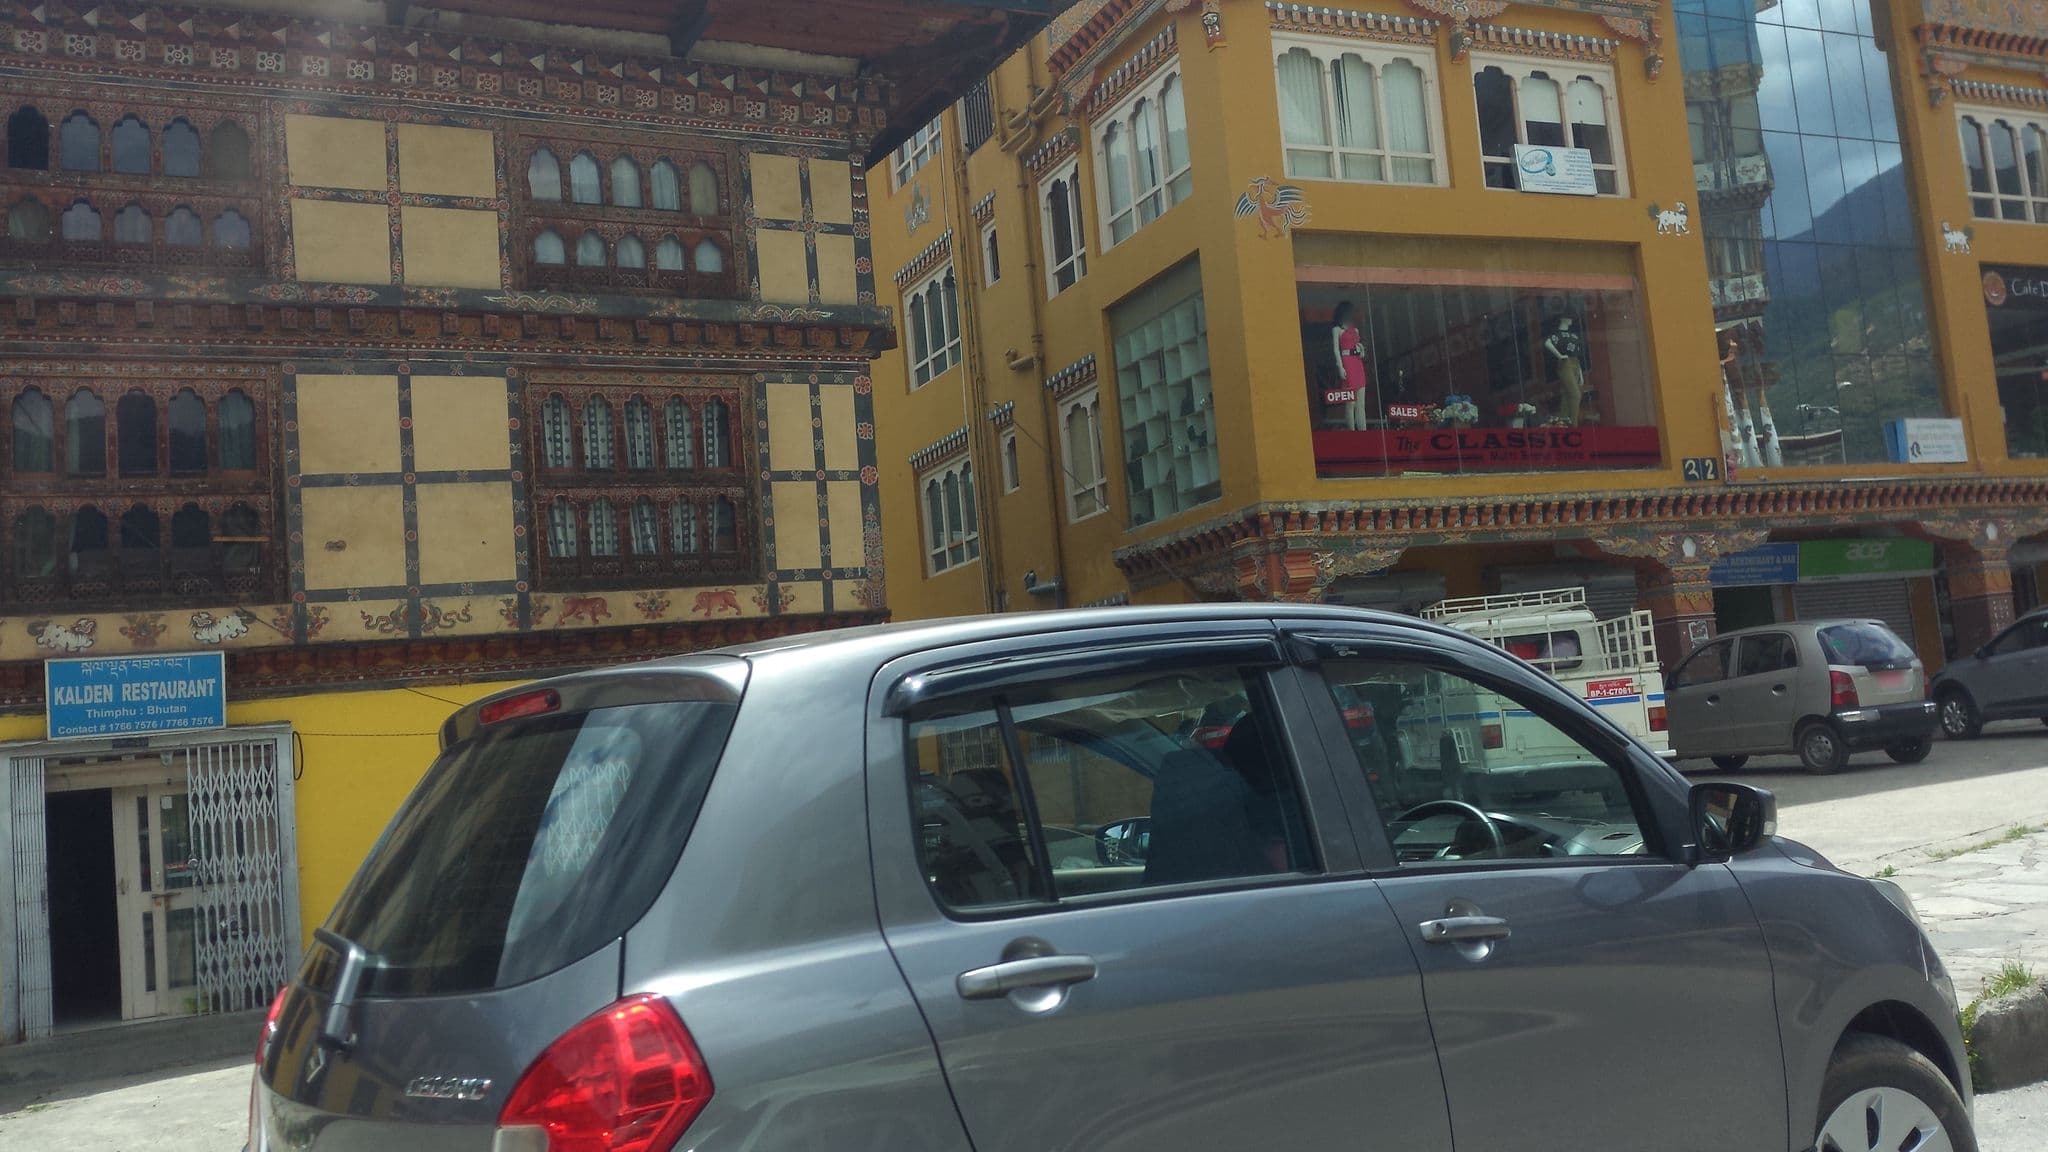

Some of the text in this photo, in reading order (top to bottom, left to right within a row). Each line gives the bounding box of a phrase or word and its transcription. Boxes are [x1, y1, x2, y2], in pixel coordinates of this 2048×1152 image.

[1327, 390, 1355, 401] OPEN
[1390, 407, 1418, 417] SALES
[1430, 432, 1582, 450] CLASSIC
[54, 678, 216, 705] KALDEN RESTAURANT
[86, 707, 136, 719] Thimphu
[147, 705, 187, 715] Bhutan
[58, 725, 97, 735] Contact
[135, 721, 158, 730] 7576
[191, 717, 214, 726] 7576
